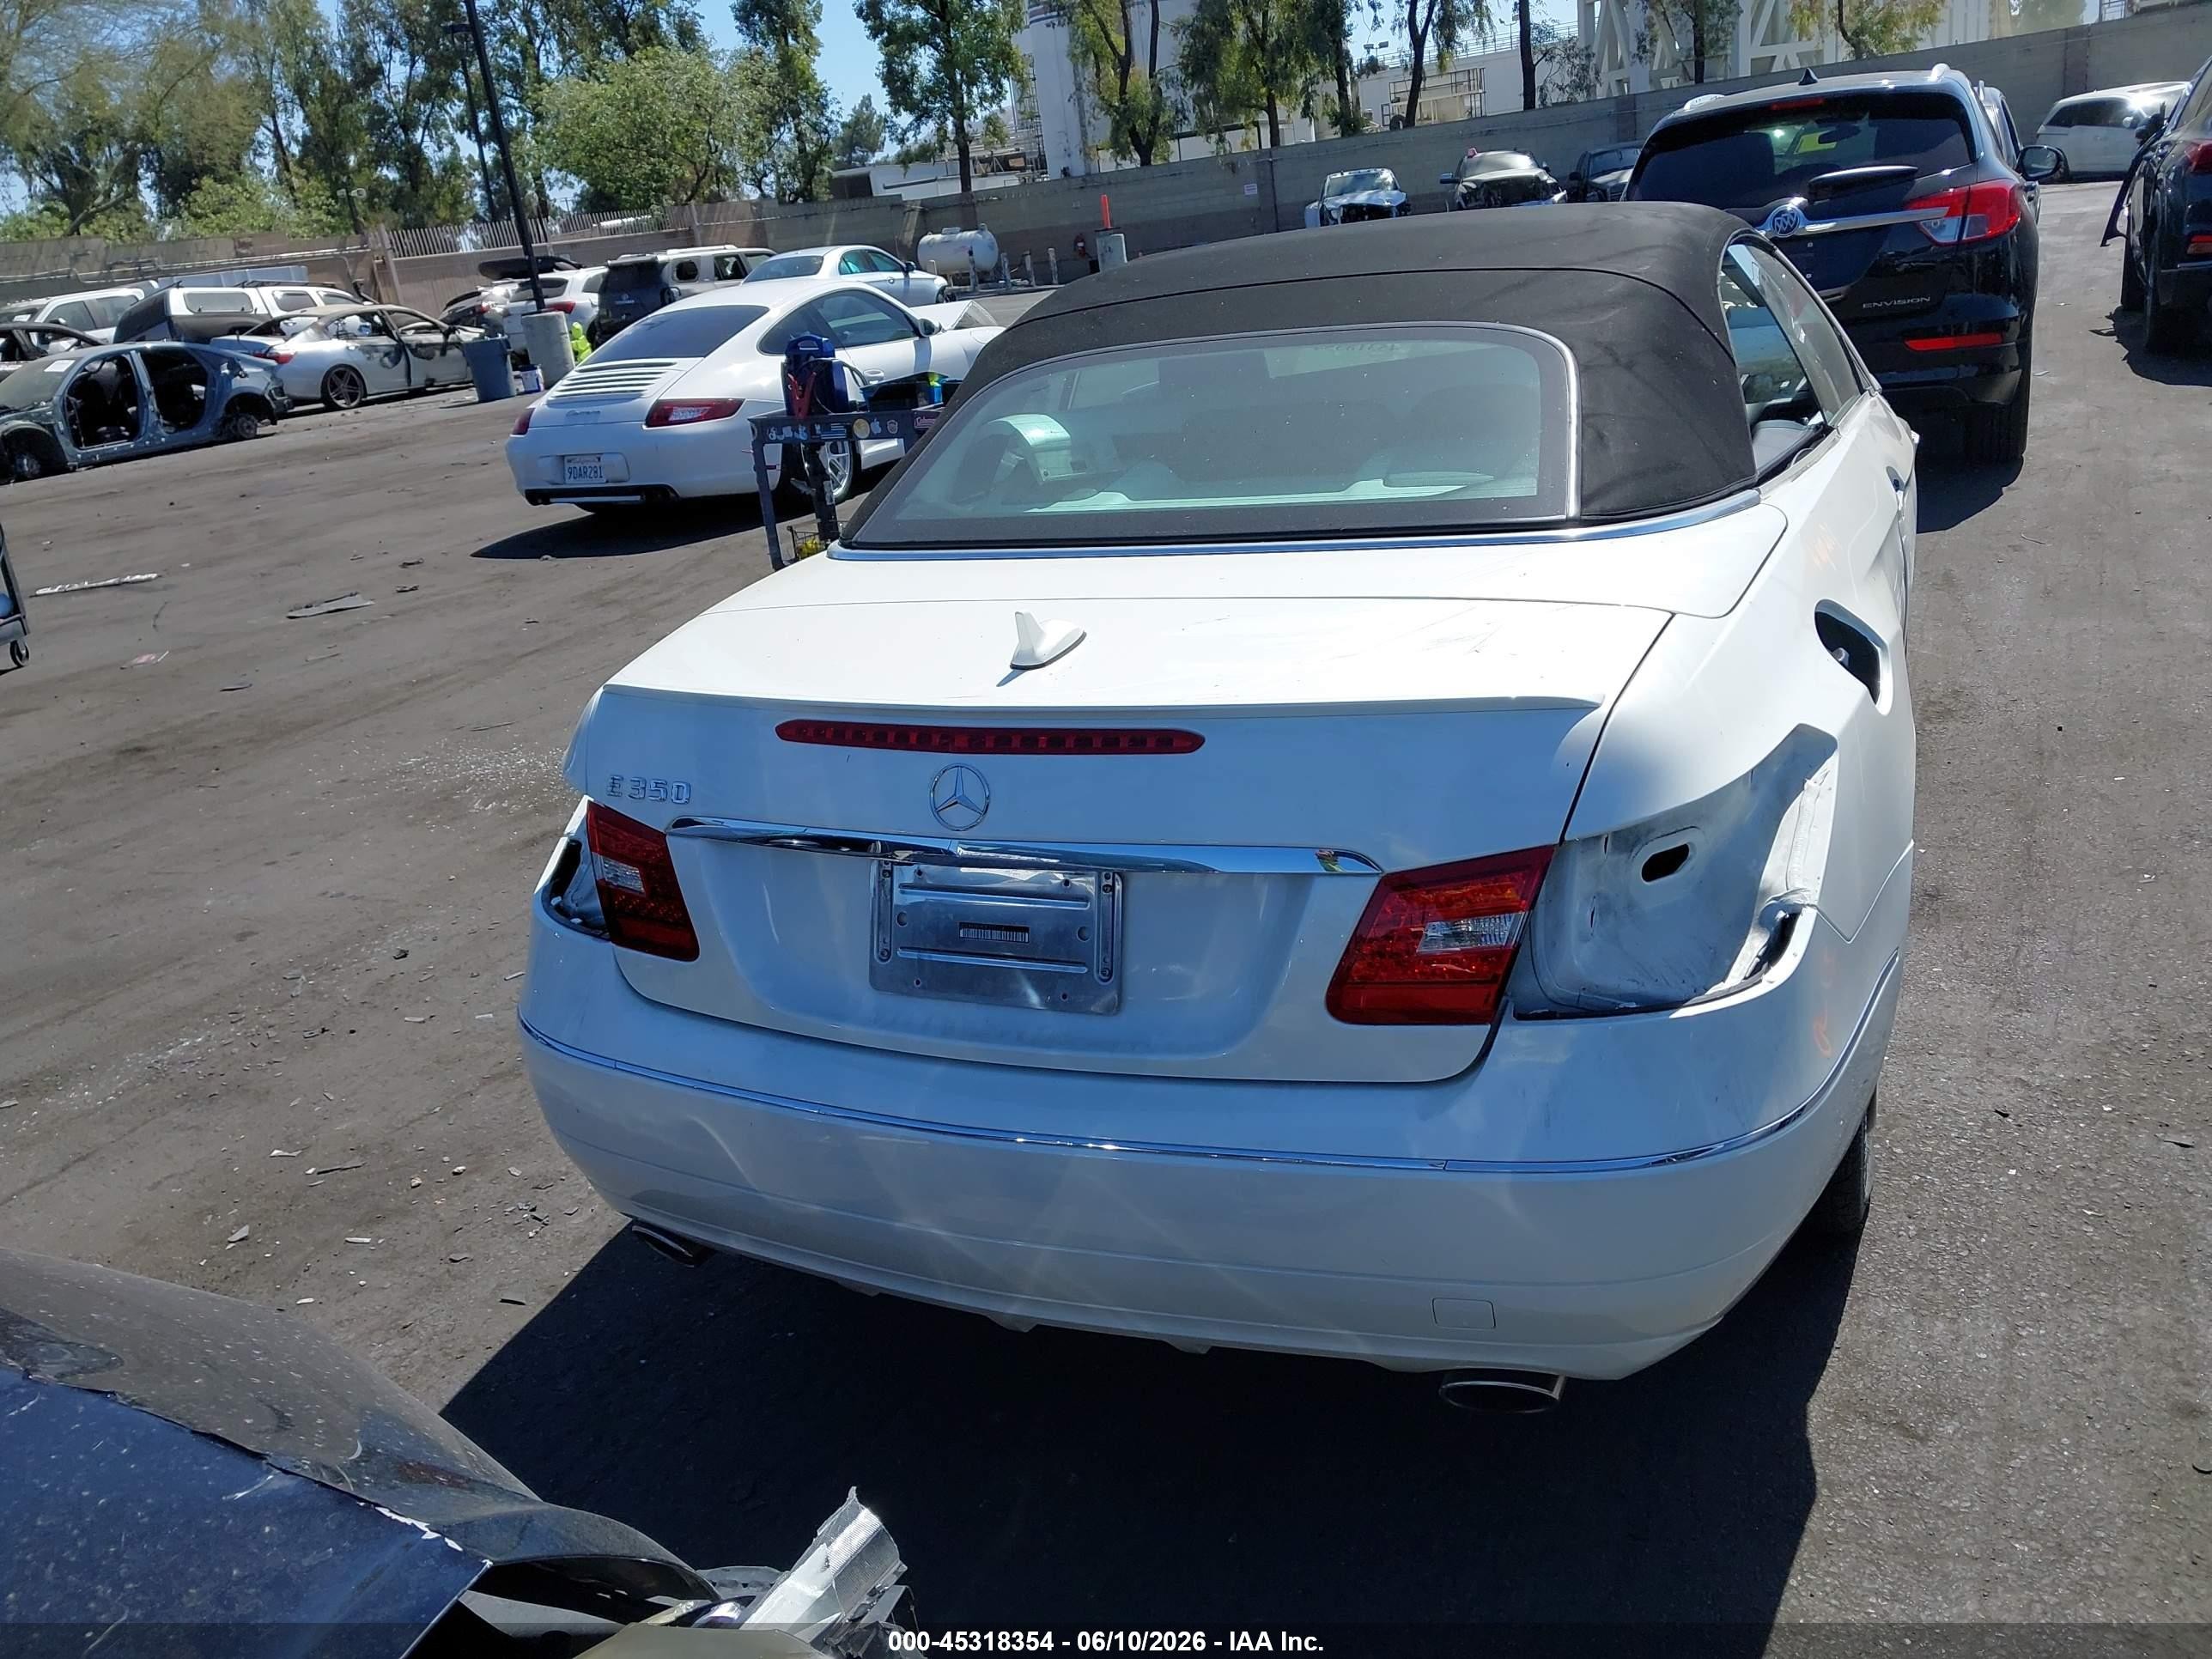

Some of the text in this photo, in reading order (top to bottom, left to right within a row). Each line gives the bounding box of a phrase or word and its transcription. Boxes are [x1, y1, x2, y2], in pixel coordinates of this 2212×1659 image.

[1863, 296, 1931, 308] ENVISION
[568, 465, 603, 479] 9DAR281
[607, 775, 691, 805] E 350
